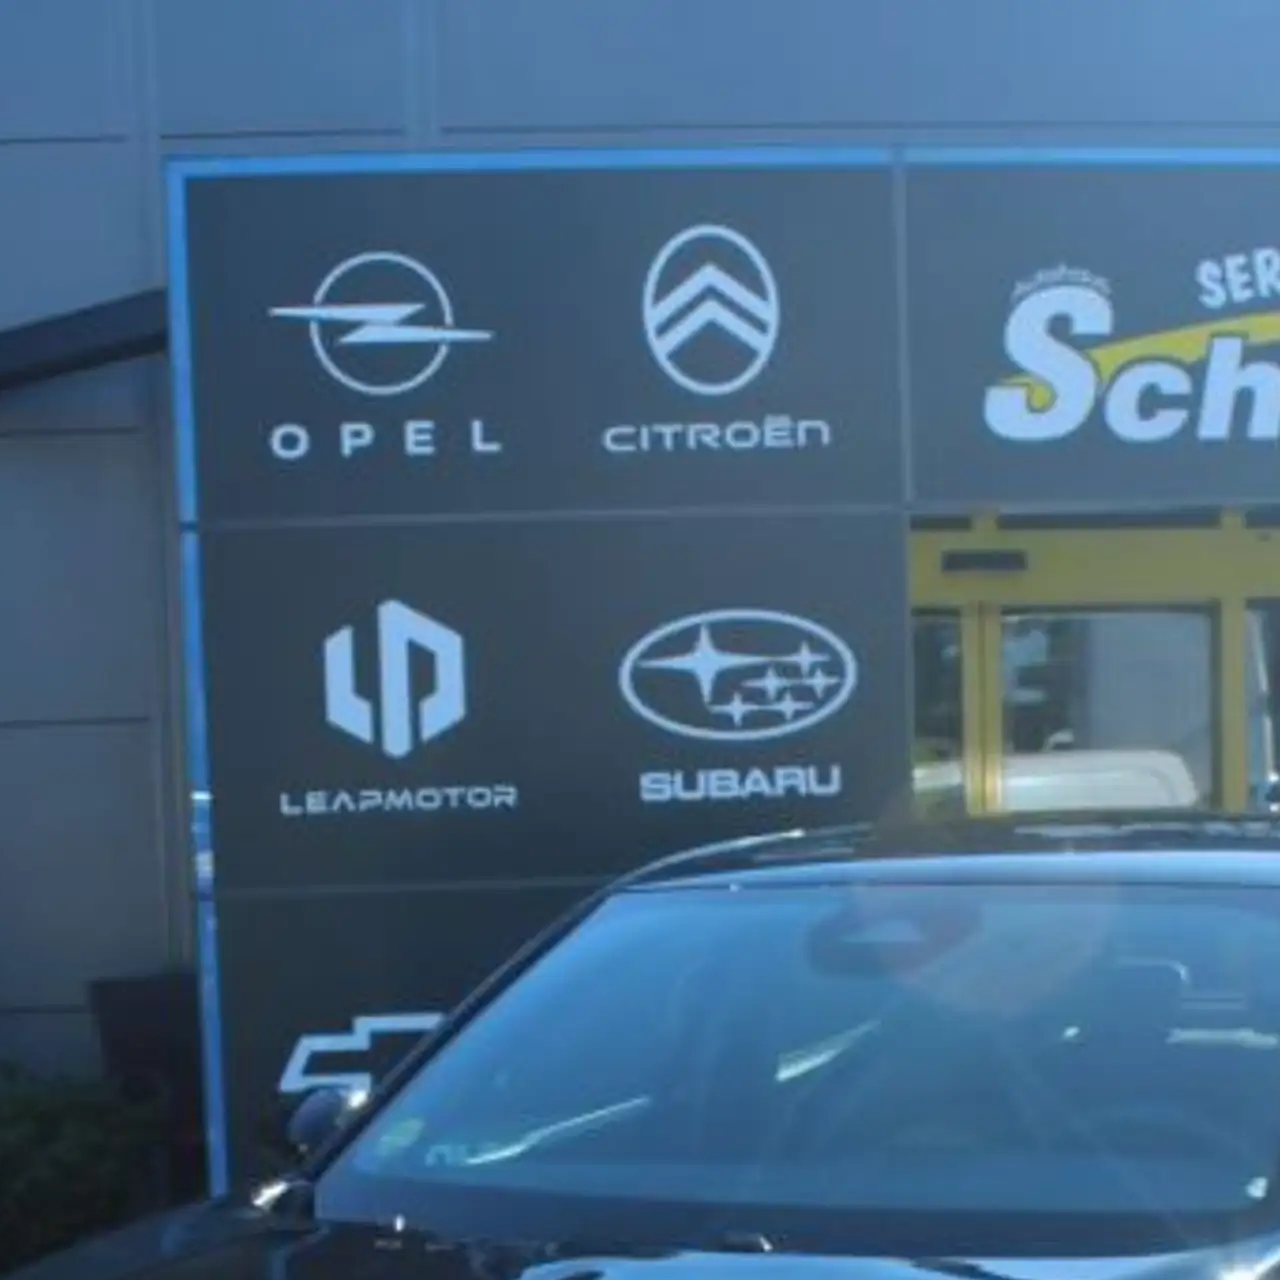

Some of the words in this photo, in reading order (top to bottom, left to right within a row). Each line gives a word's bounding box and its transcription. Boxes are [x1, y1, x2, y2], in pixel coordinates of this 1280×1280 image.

[269, 420, 503, 461] OPEL
[279, 784, 519, 816] LEAPMOTOR
[638, 766, 841, 804] SUBARU
